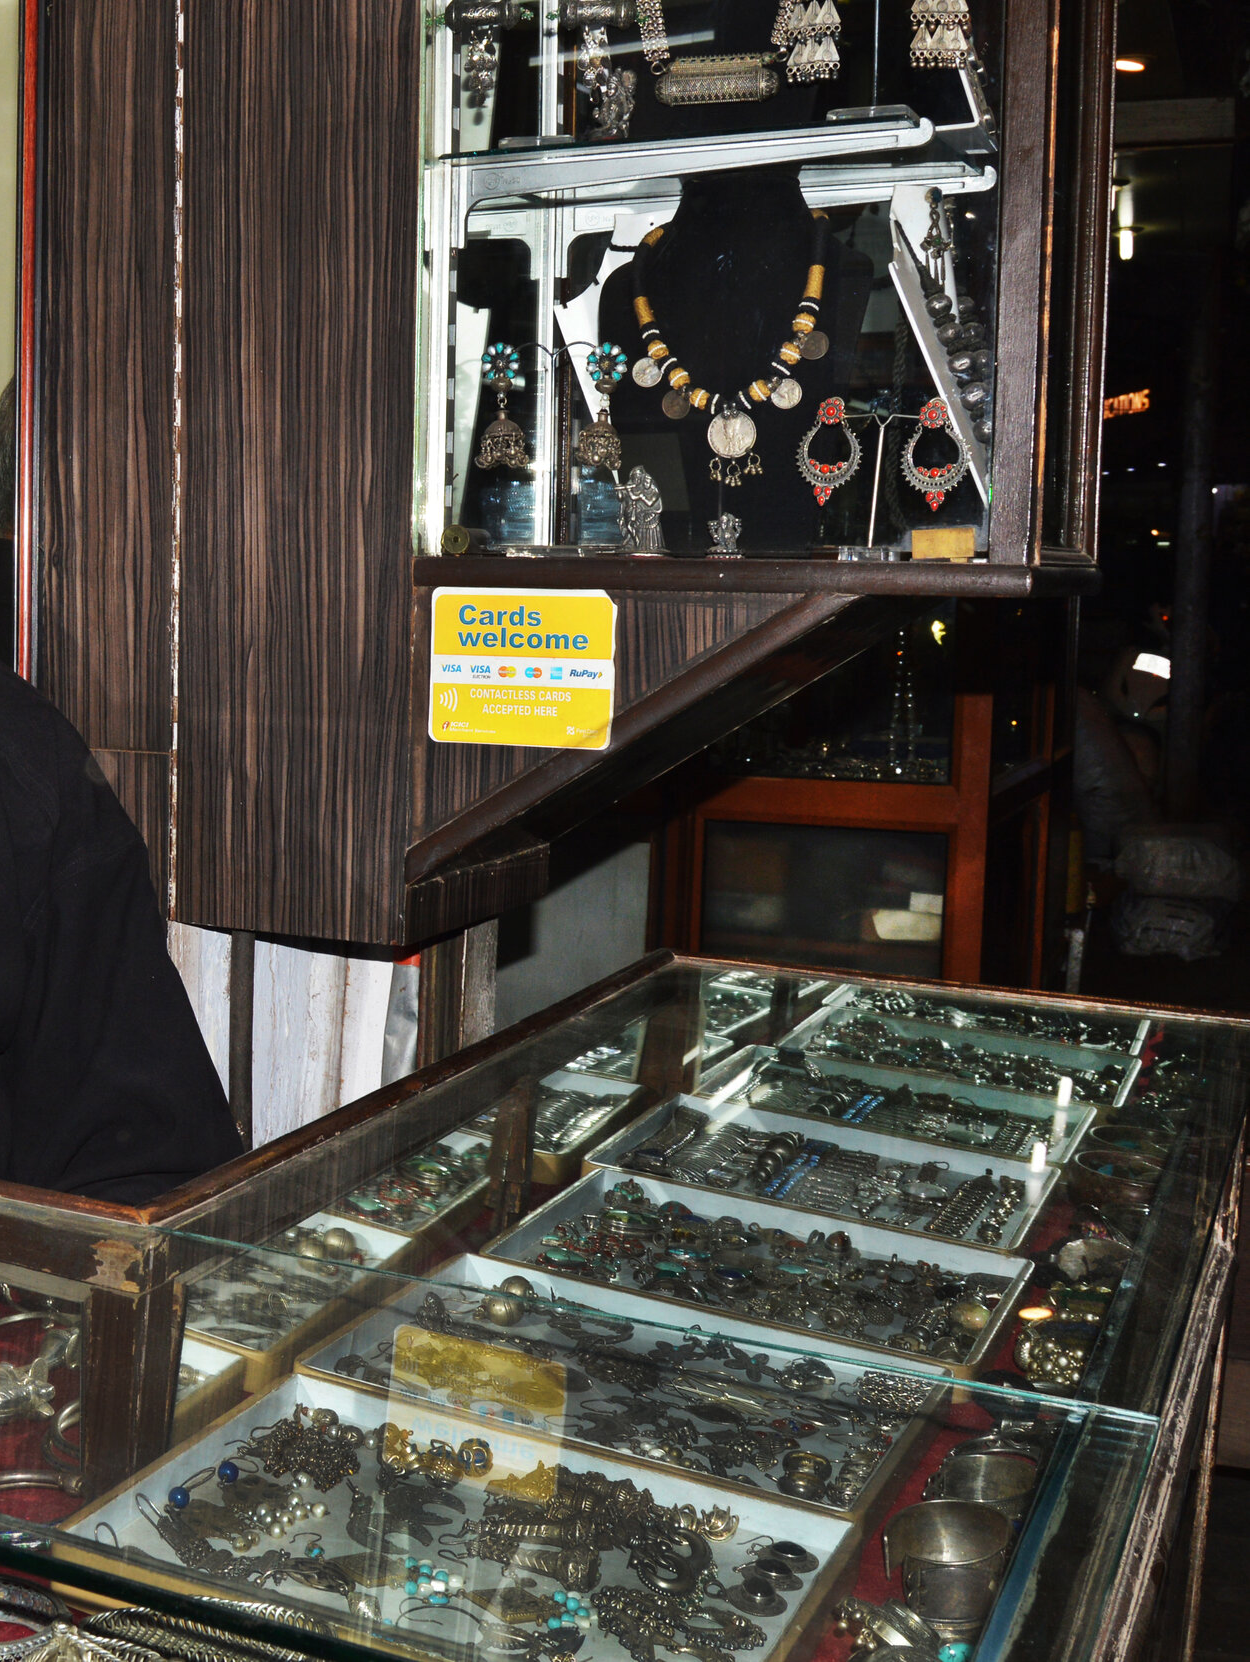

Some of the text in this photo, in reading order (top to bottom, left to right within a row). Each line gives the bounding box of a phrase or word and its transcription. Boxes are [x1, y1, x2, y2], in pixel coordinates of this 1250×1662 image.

[458, 604, 542, 626] Cards
[457, 627, 589, 650] welcome
[441, 664, 462, 673] VISA
[470, 665, 491, 674] VISA
[569, 669, 599, 680] RuPay
[470, 688, 572, 703] CONTACTLESS CARDS
[482, 704, 558, 717] ACCEPTED HERE
